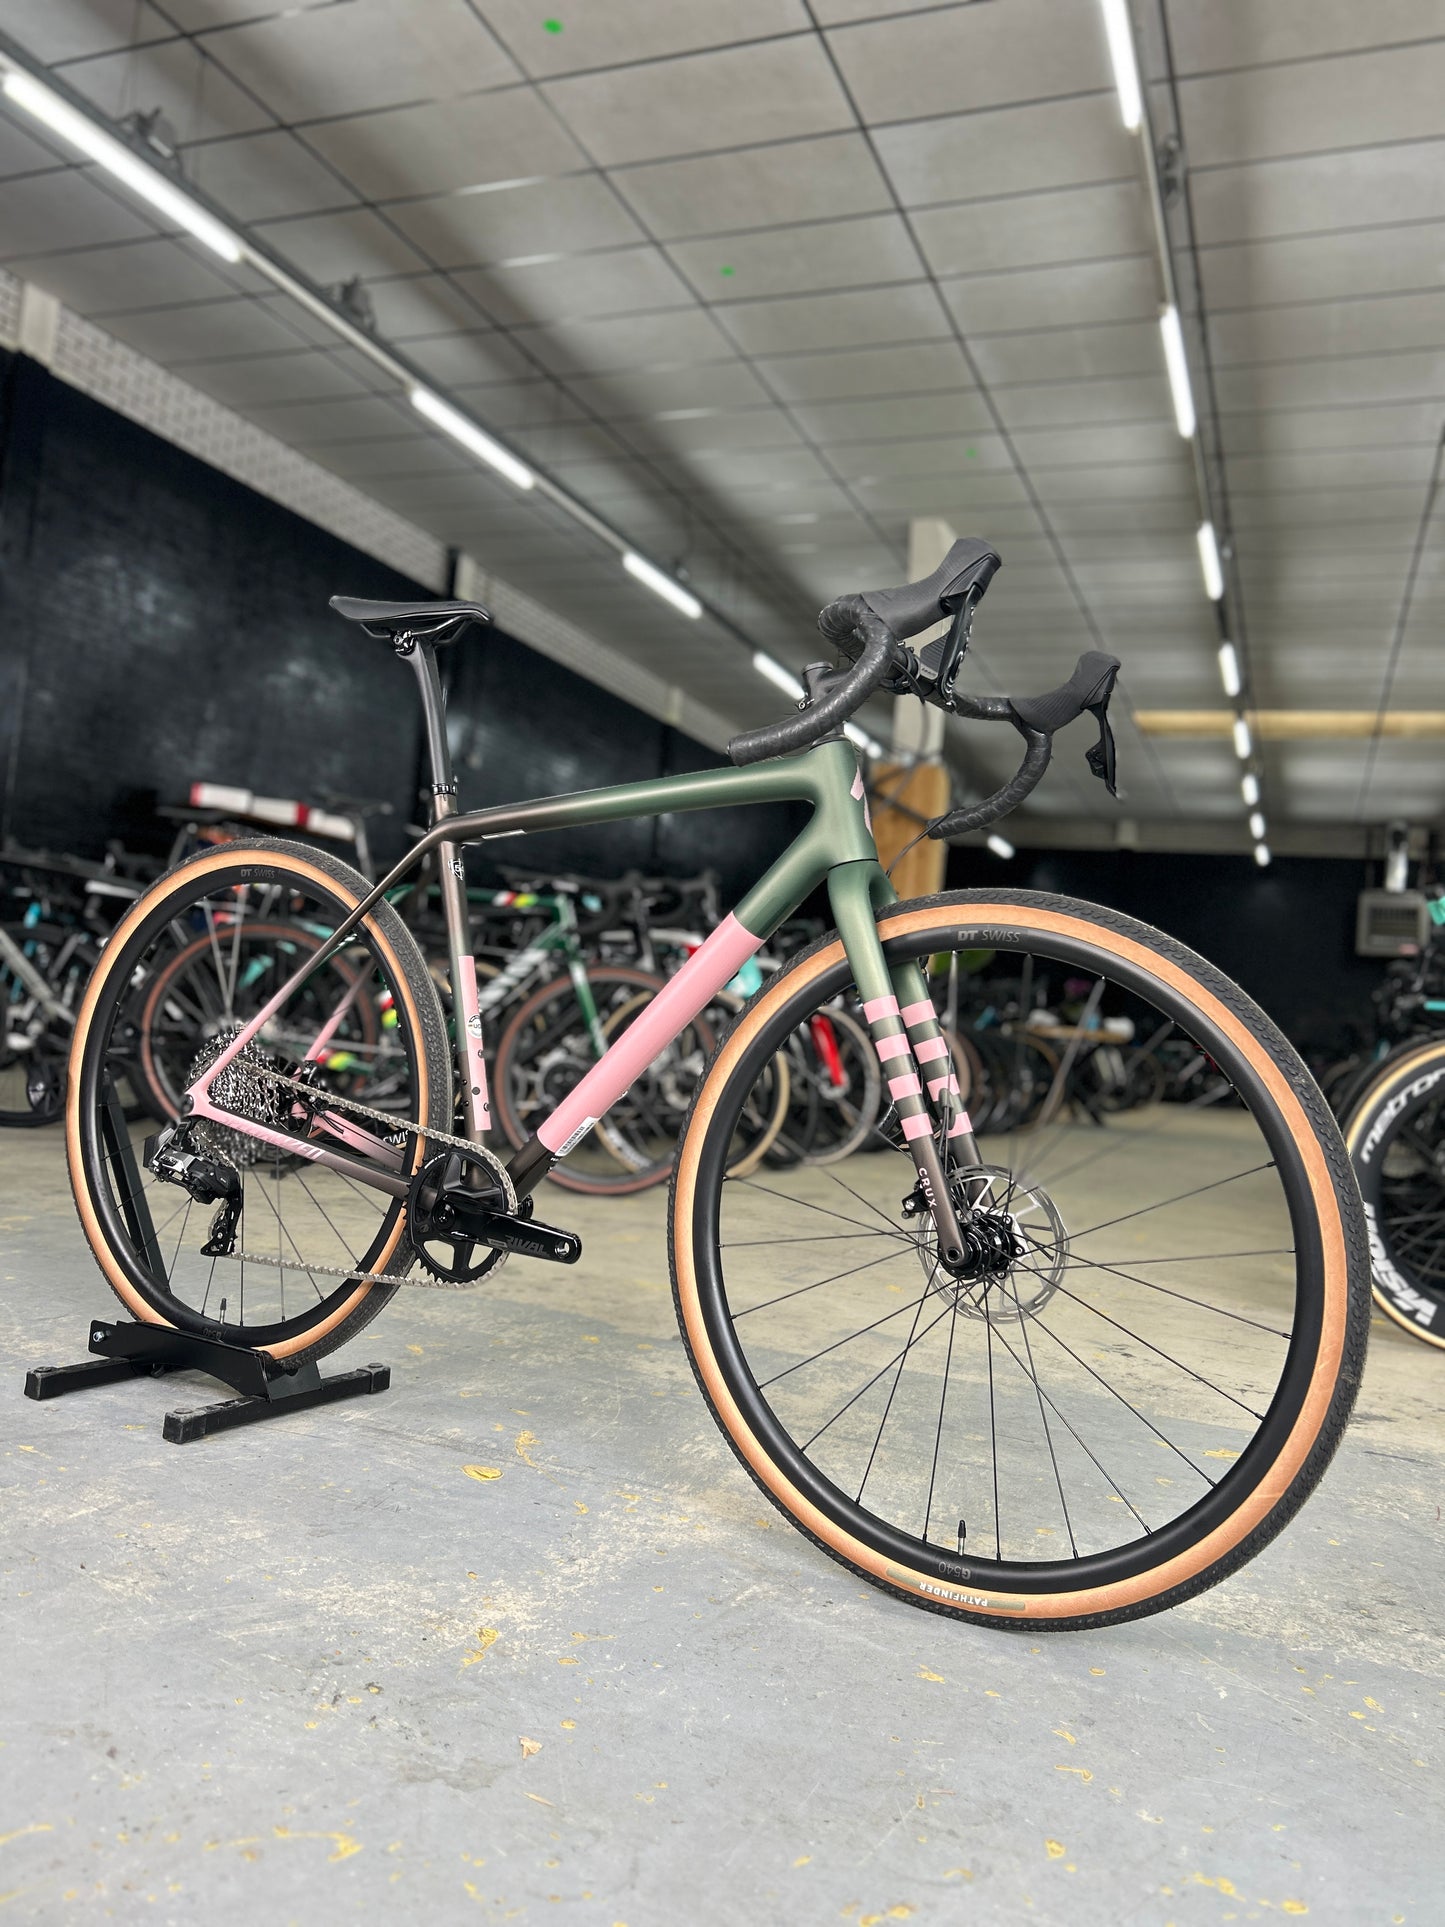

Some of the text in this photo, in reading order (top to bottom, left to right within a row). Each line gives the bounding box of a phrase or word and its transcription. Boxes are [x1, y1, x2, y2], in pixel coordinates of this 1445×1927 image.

[240, 868, 276, 879] DT SWISS
[957, 929, 1021, 942] DT SWISS
[918, 1167, 938, 1208] CRUX
[505, 1235, 549, 1257] RIVAL
[938, 1561, 971, 1580] G540
[919, 1582, 988, 1607] PATHFINDER
